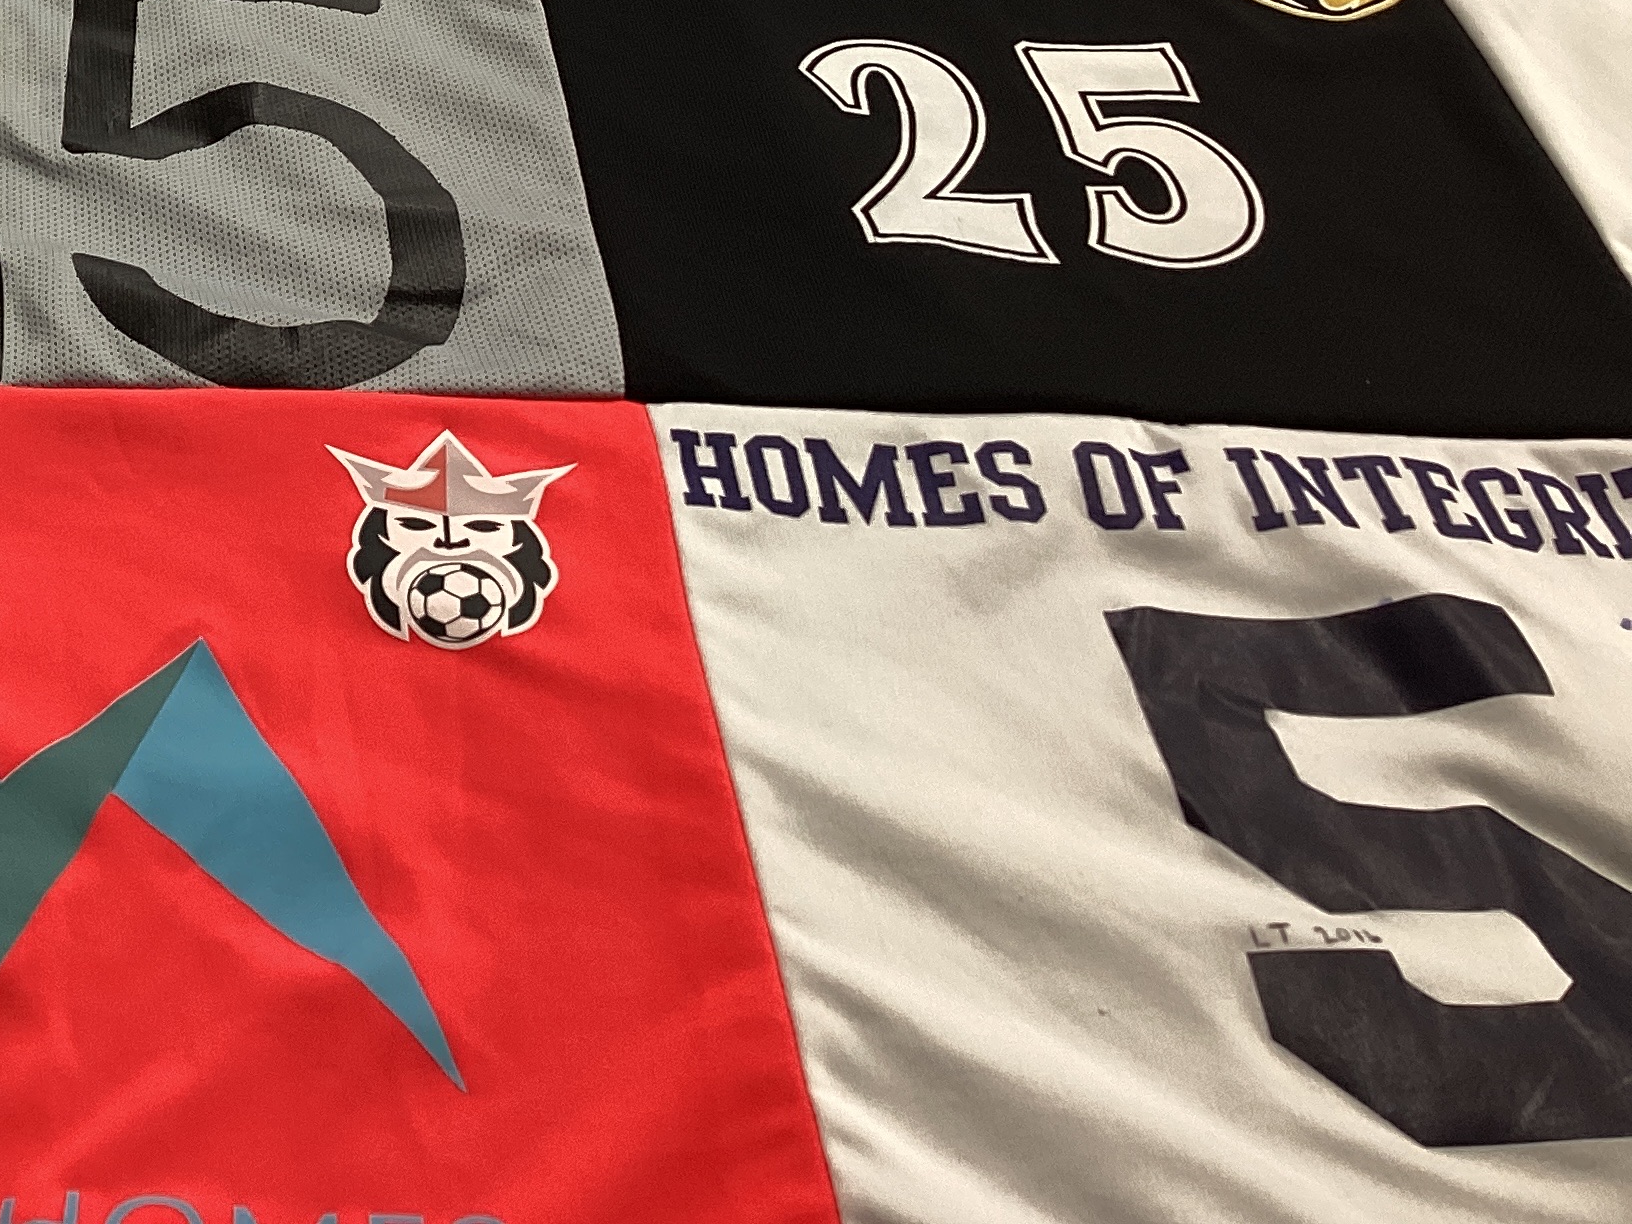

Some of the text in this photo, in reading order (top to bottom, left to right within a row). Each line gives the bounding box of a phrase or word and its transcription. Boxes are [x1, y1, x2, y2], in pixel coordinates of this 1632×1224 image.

[798, 38, 1267, 270] 25
[670, 428, 1049, 530] HOMES
[1072, 440, 1194, 532] OF
[1102, 592, 1632, 1152] 5
